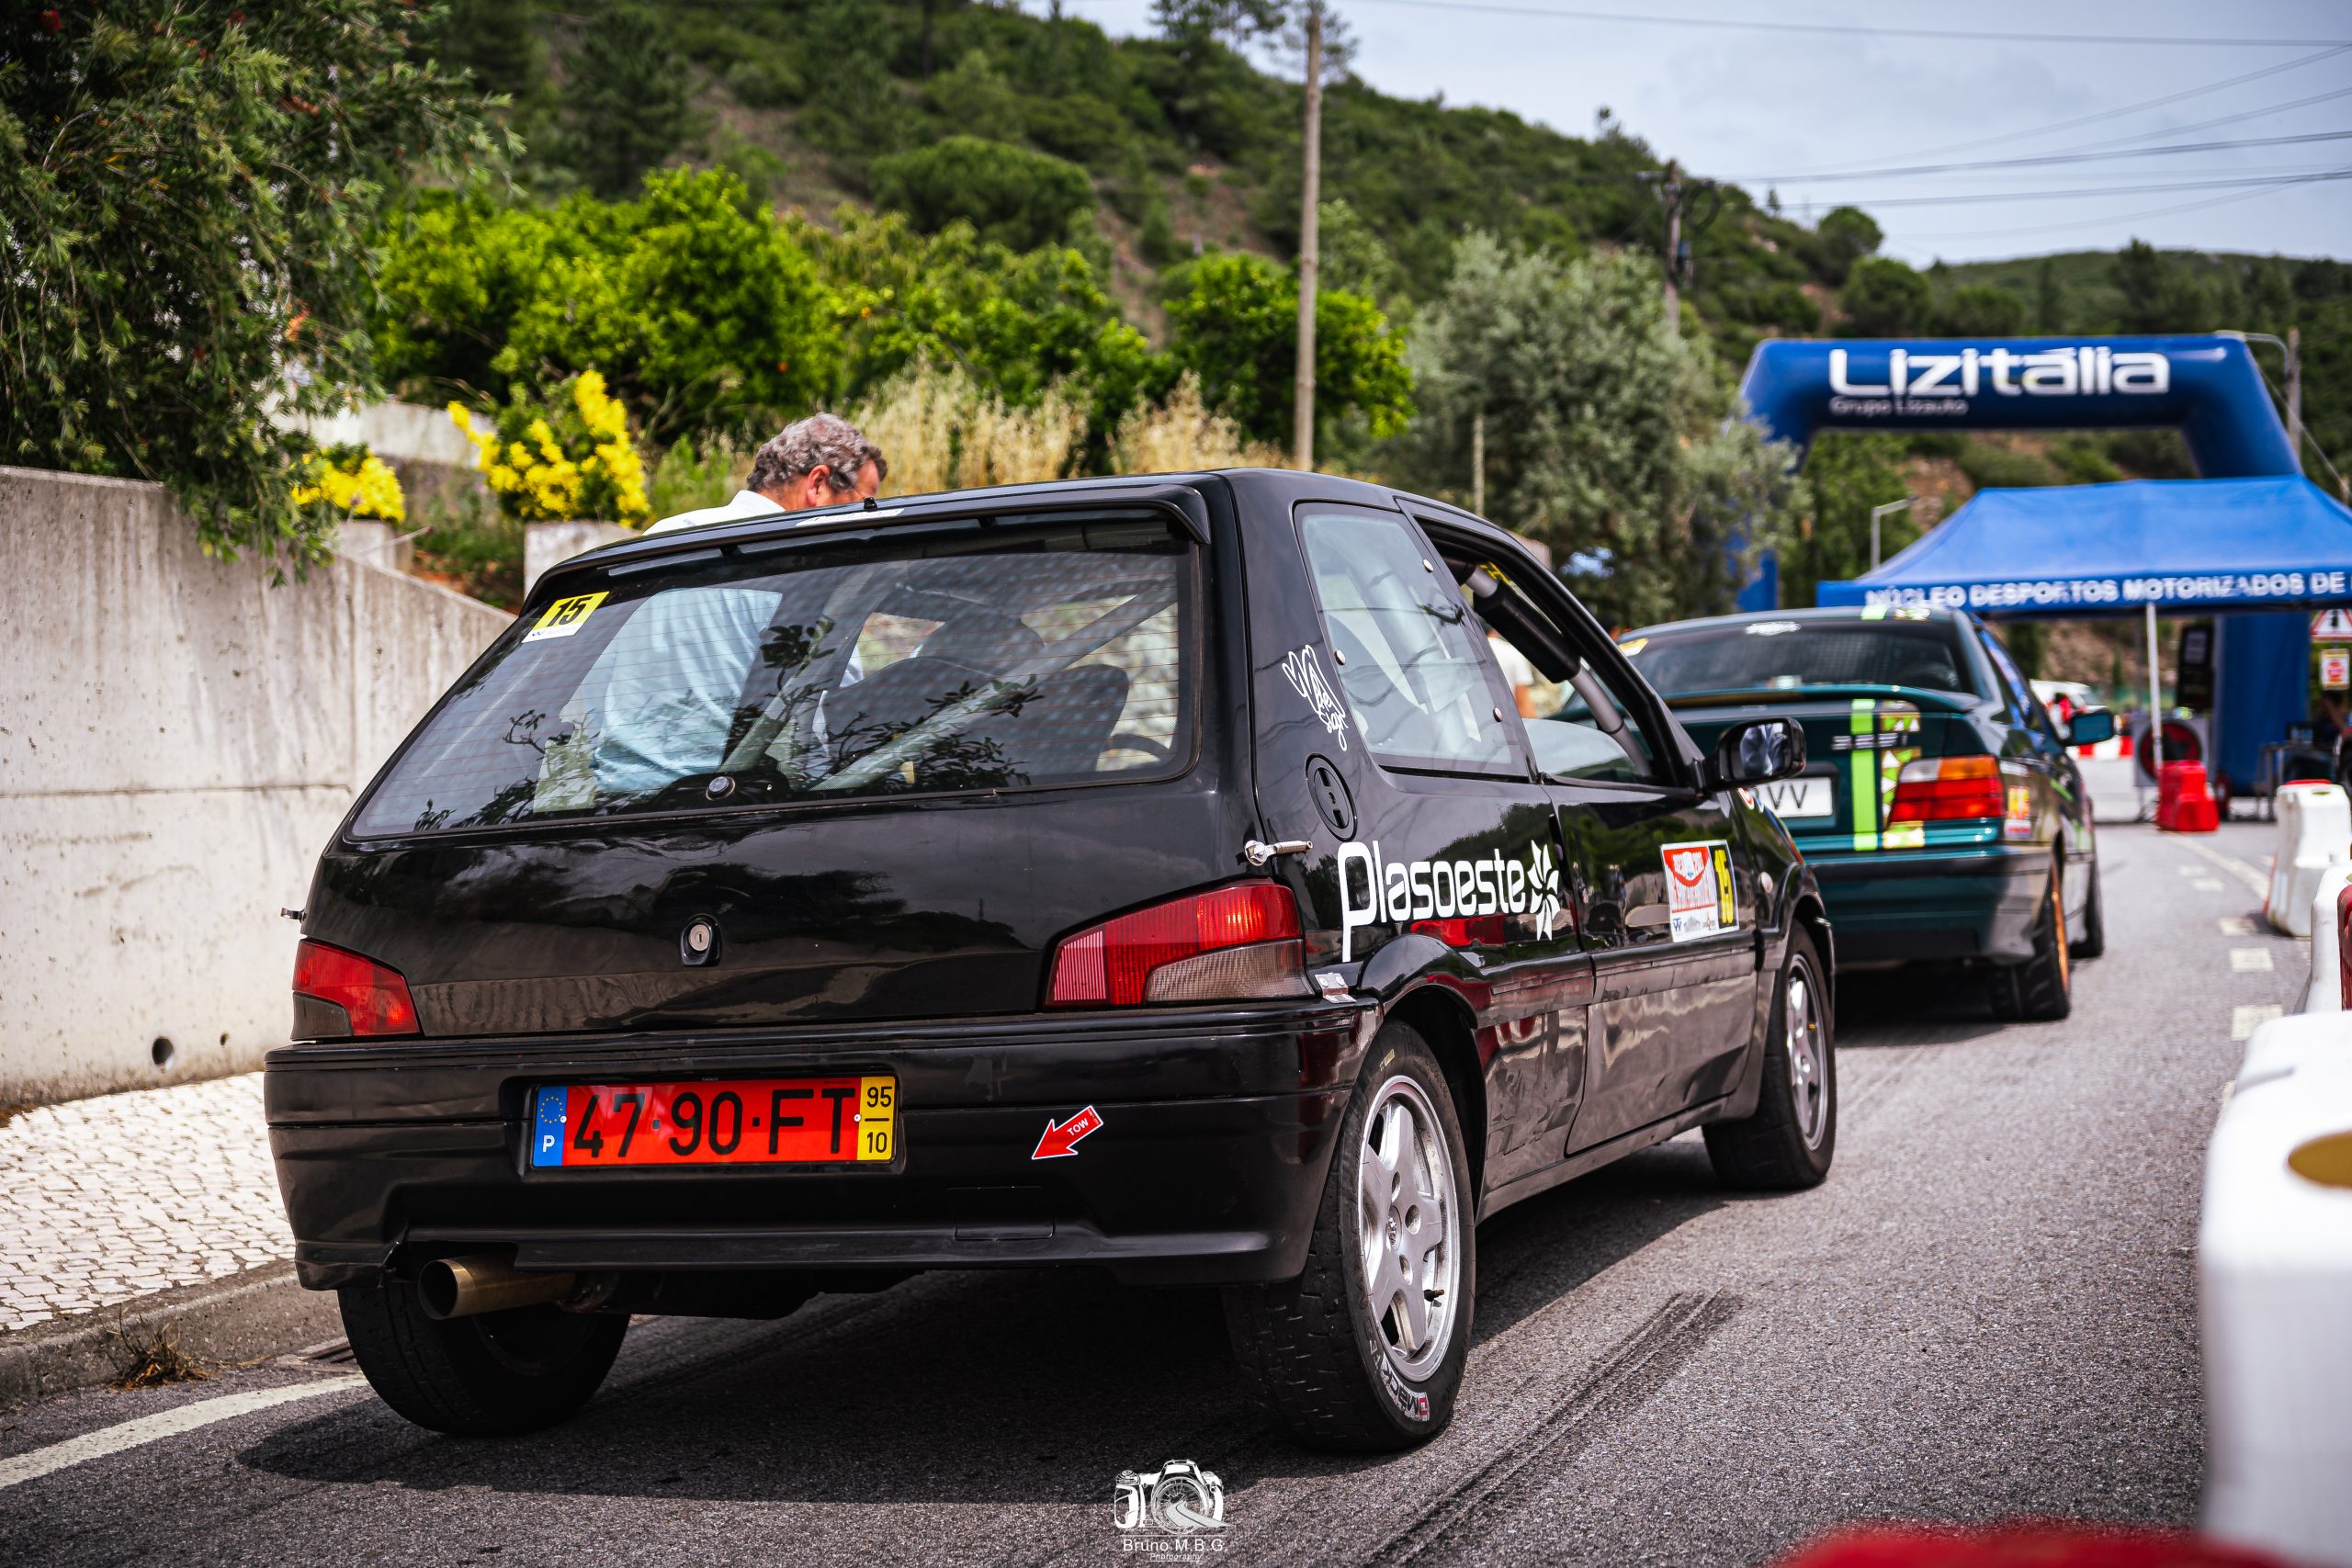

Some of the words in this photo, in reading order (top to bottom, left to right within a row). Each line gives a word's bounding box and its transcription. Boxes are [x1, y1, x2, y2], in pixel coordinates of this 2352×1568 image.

[1828, 396, 1893, 417] Grupo
[1968, 579, 2119, 607] DESPORTOS
[2122, 573, 2304, 601] MOTORIZADOS
[2310, 571, 2346, 594] DE
[547, 596, 594, 626] 15
[866, 1086, 893, 1108] 95
[1067, 1118, 1089, 1136] TOW
[542, 1135, 555, 1153] P
[866, 1132, 888, 1153] 10
